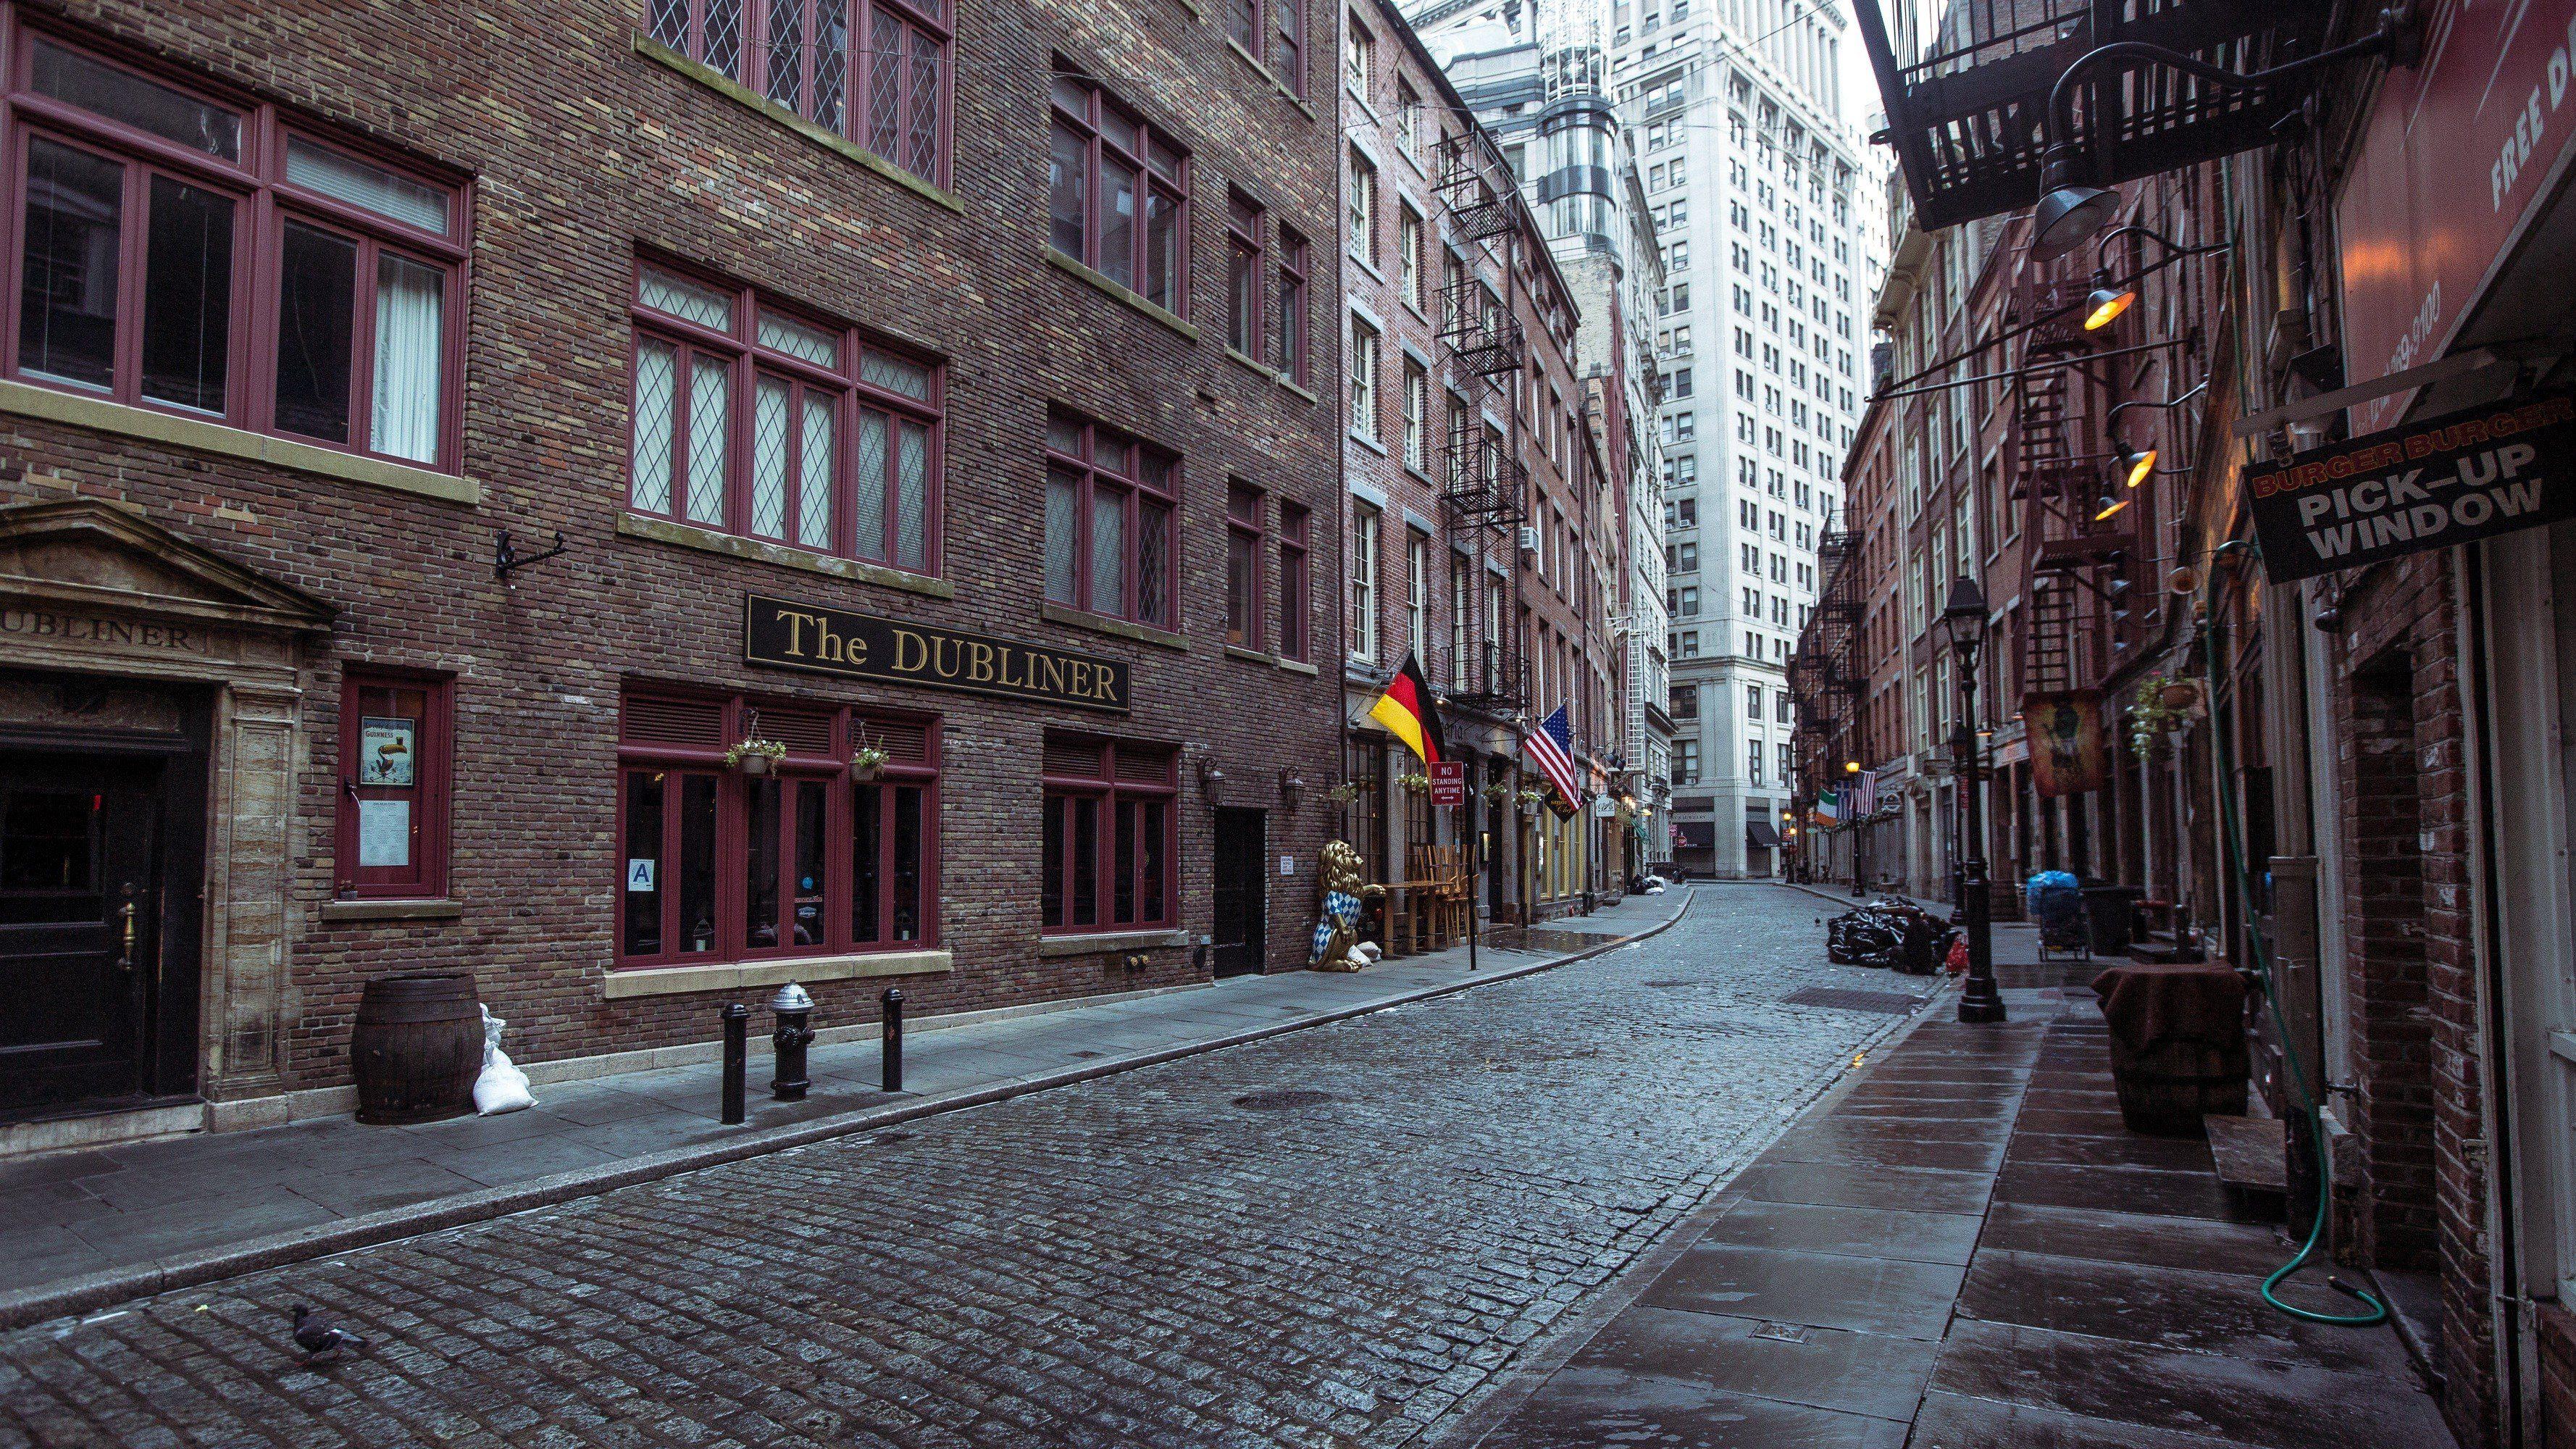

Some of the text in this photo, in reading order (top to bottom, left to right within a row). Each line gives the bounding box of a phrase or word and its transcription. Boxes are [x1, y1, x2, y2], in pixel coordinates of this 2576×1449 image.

[2491, 84, 2543, 213] FREE
[2252, 397, 2574, 499] BURGER BURGER
[2306, 477, 2543, 559] WINDOW
[776, 609, 1118, 701] The DUBLINER
[1441, 767, 1452, 775] NO
[633, 863, 650, 882] A
